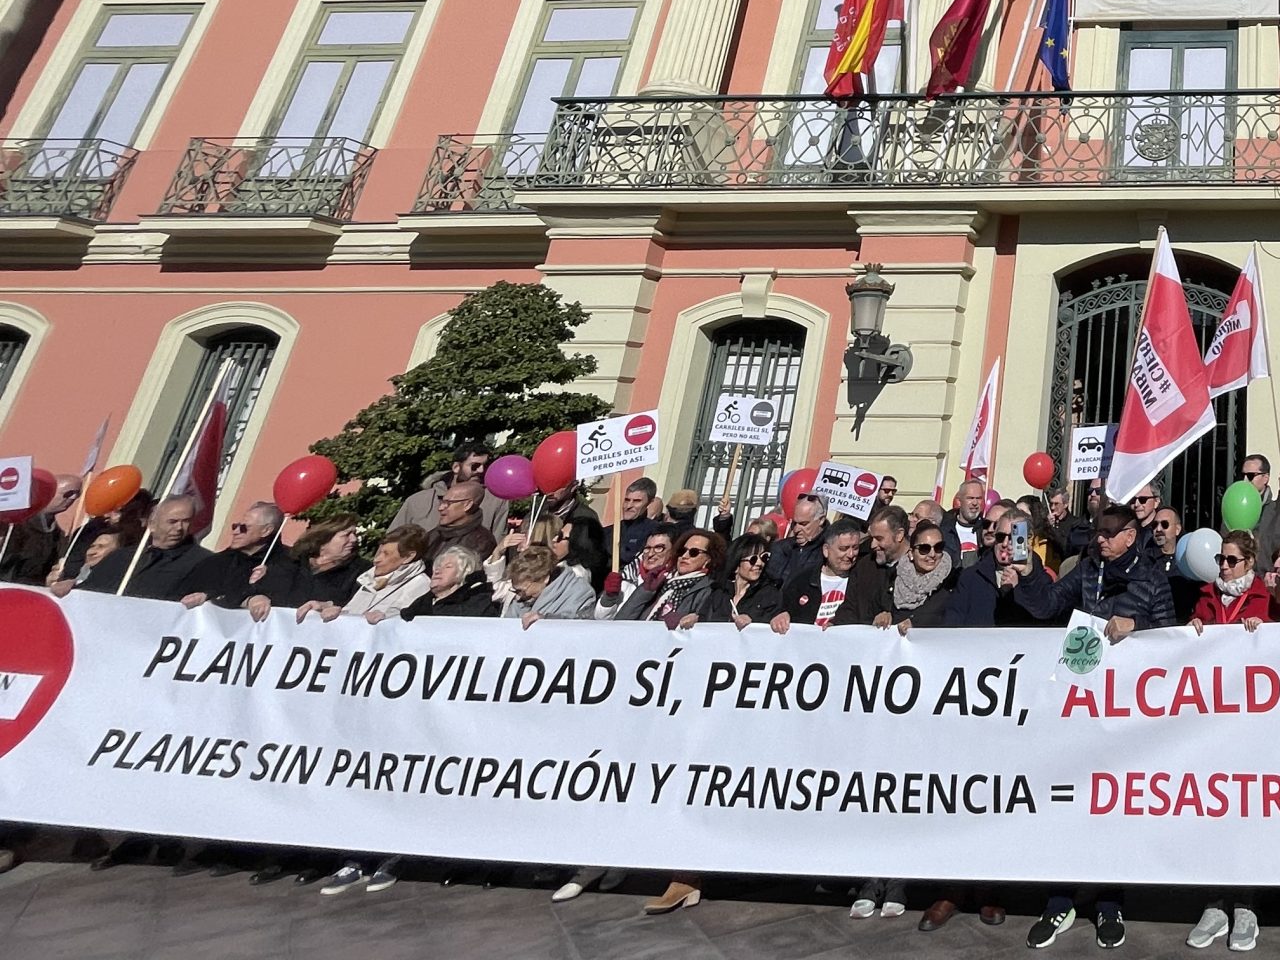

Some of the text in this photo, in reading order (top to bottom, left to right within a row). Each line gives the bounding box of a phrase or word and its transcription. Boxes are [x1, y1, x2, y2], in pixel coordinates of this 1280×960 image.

[580, 451, 622, 464] CARRILES
[624, 447, 642, 456] BICI
[593, 461, 614, 472] PERO
[616, 459, 628, 467] NO
[1077, 465, 1099, 474] PERO
[815, 486, 847, 498] CARRILES
[848, 493, 861, 502] BUS
[837, 499, 849, 507] NO
[143, 636, 273, 688] PLAN
[275, 646, 338, 693] DE
[340, 650, 617, 705] MOVILIDAD
[628, 647, 683, 716] SÍ,
[702, 661, 830, 712] PERO
[842, 664, 922, 715] NO
[932, 653, 1029, 726] ASÍ,
[87, 728, 250, 779] PLANES
[249, 743, 323, 785] SIN
[325, 749, 637, 803] PARTICIPACIÓN
[650, 763, 677, 805] Y
[686, 764, 1037, 814] TRANSPARENCIA
